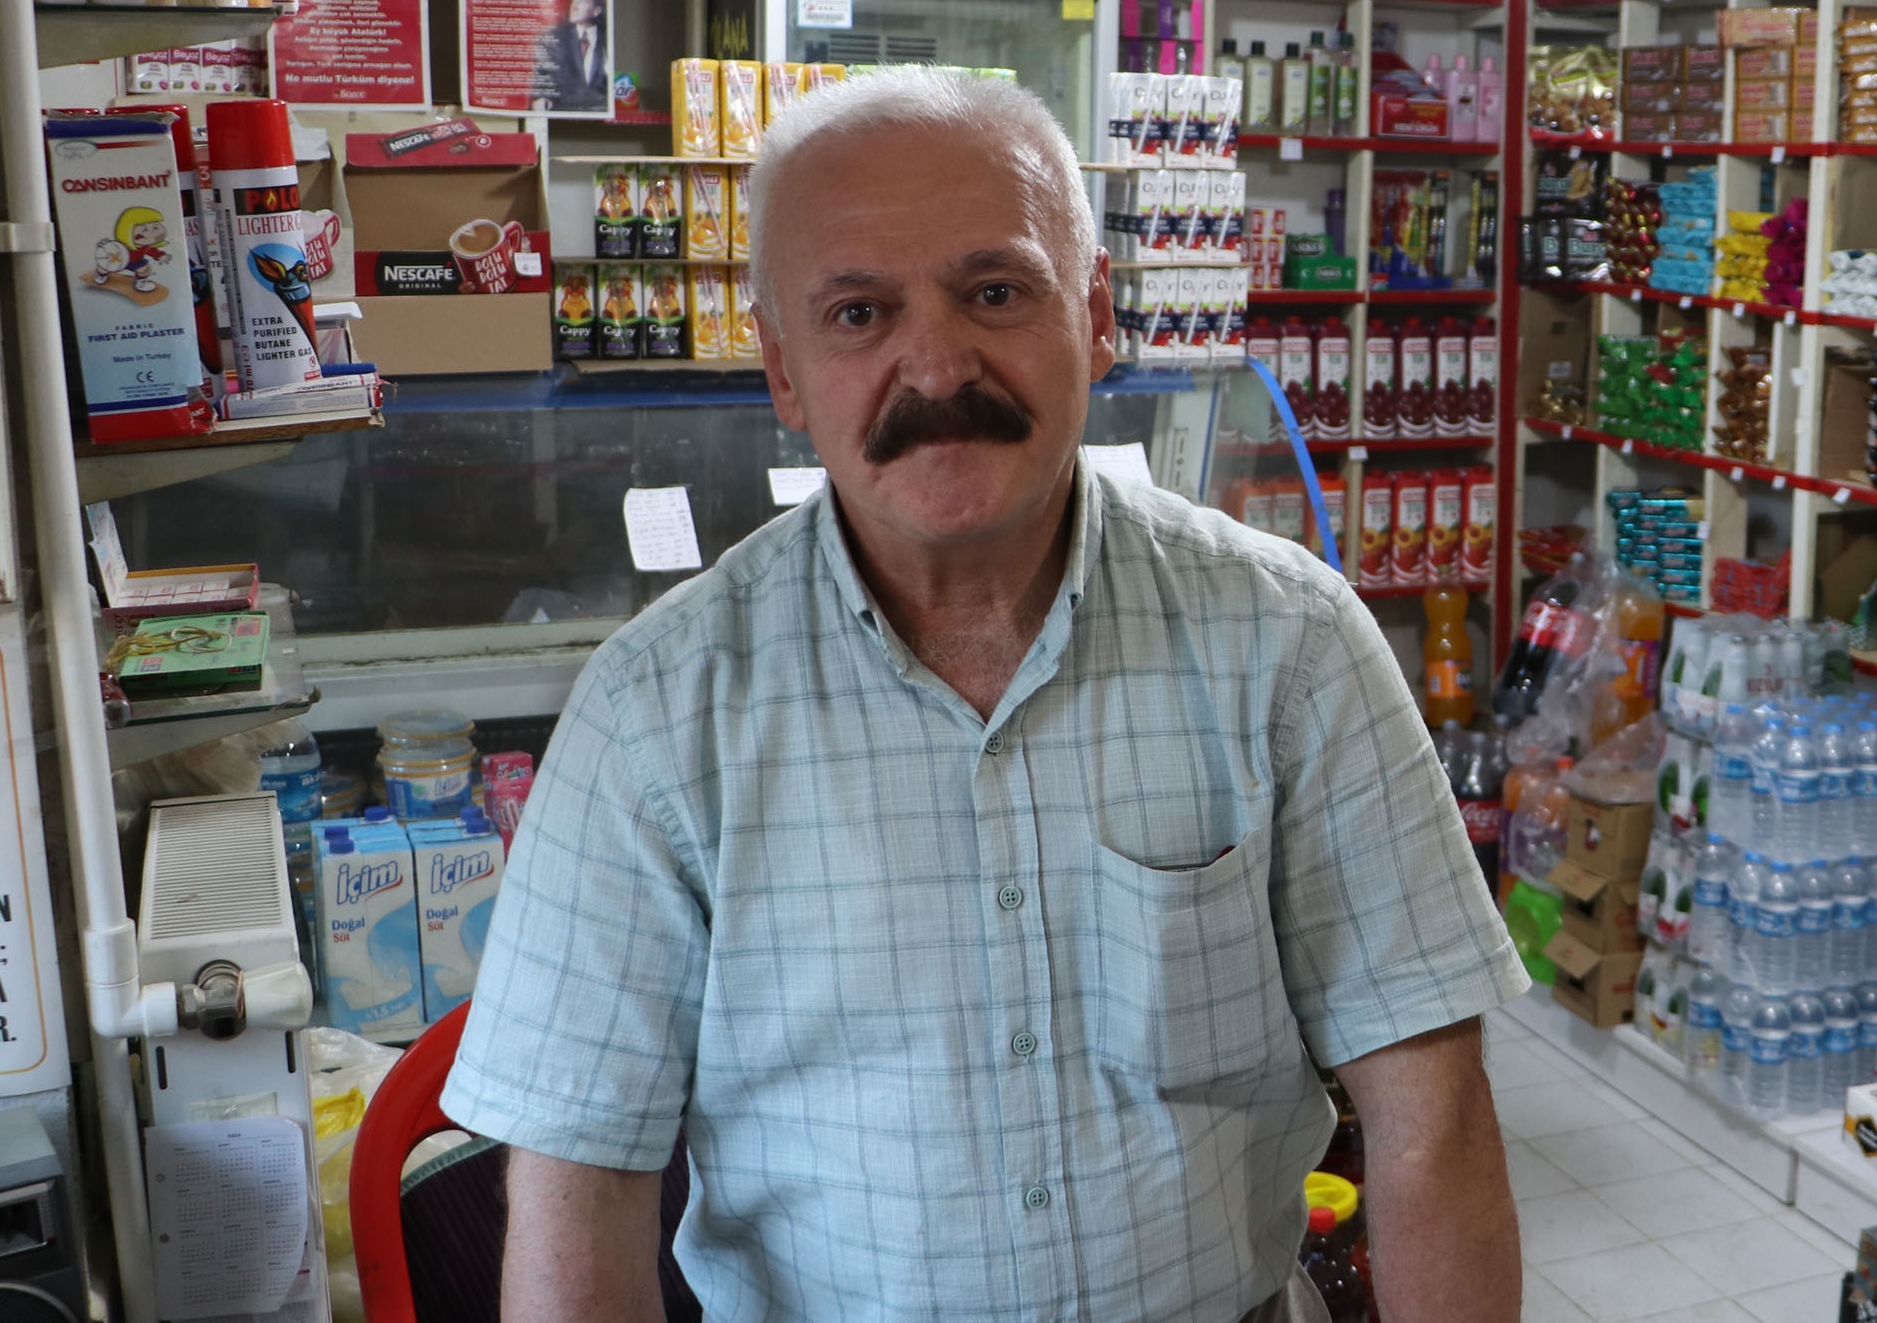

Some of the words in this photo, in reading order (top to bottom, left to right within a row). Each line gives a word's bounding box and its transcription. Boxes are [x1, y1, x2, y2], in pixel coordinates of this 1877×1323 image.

[323, 27, 349, 36] büyük
[351, 27, 387, 36] Atatürk!
[285, 73, 299, 83] Ne
[302, 73, 333, 83] mutlu
[336, 74, 375, 84] Türküm
[377, 74, 415, 85] diyene!
[237, 214, 294, 235] LIGHTER
[252, 316, 283, 327] EXTRA
[88, 333, 117, 343] FIRST
[120, 331, 138, 341] AID
[140, 327, 185, 339] PLASTER
[253, 326, 298, 338] PURIFIED
[559, 325, 592, 338] Cappy
[255, 338, 292, 349] BUTANE
[113, 355, 135, 363] Made
[146, 352, 172, 361] Turkey
[256, 349, 296, 361] LIGHTER
[298, 347, 313, 358] GAS
[431, 851, 490, 894] İçim
[336, 861, 399, 905] İçim
[426, 905, 459, 920] Doğal
[332, 917, 366, 932] Doğal
[427, 920, 444, 931] Süt
[333, 932, 350, 943] Süt
